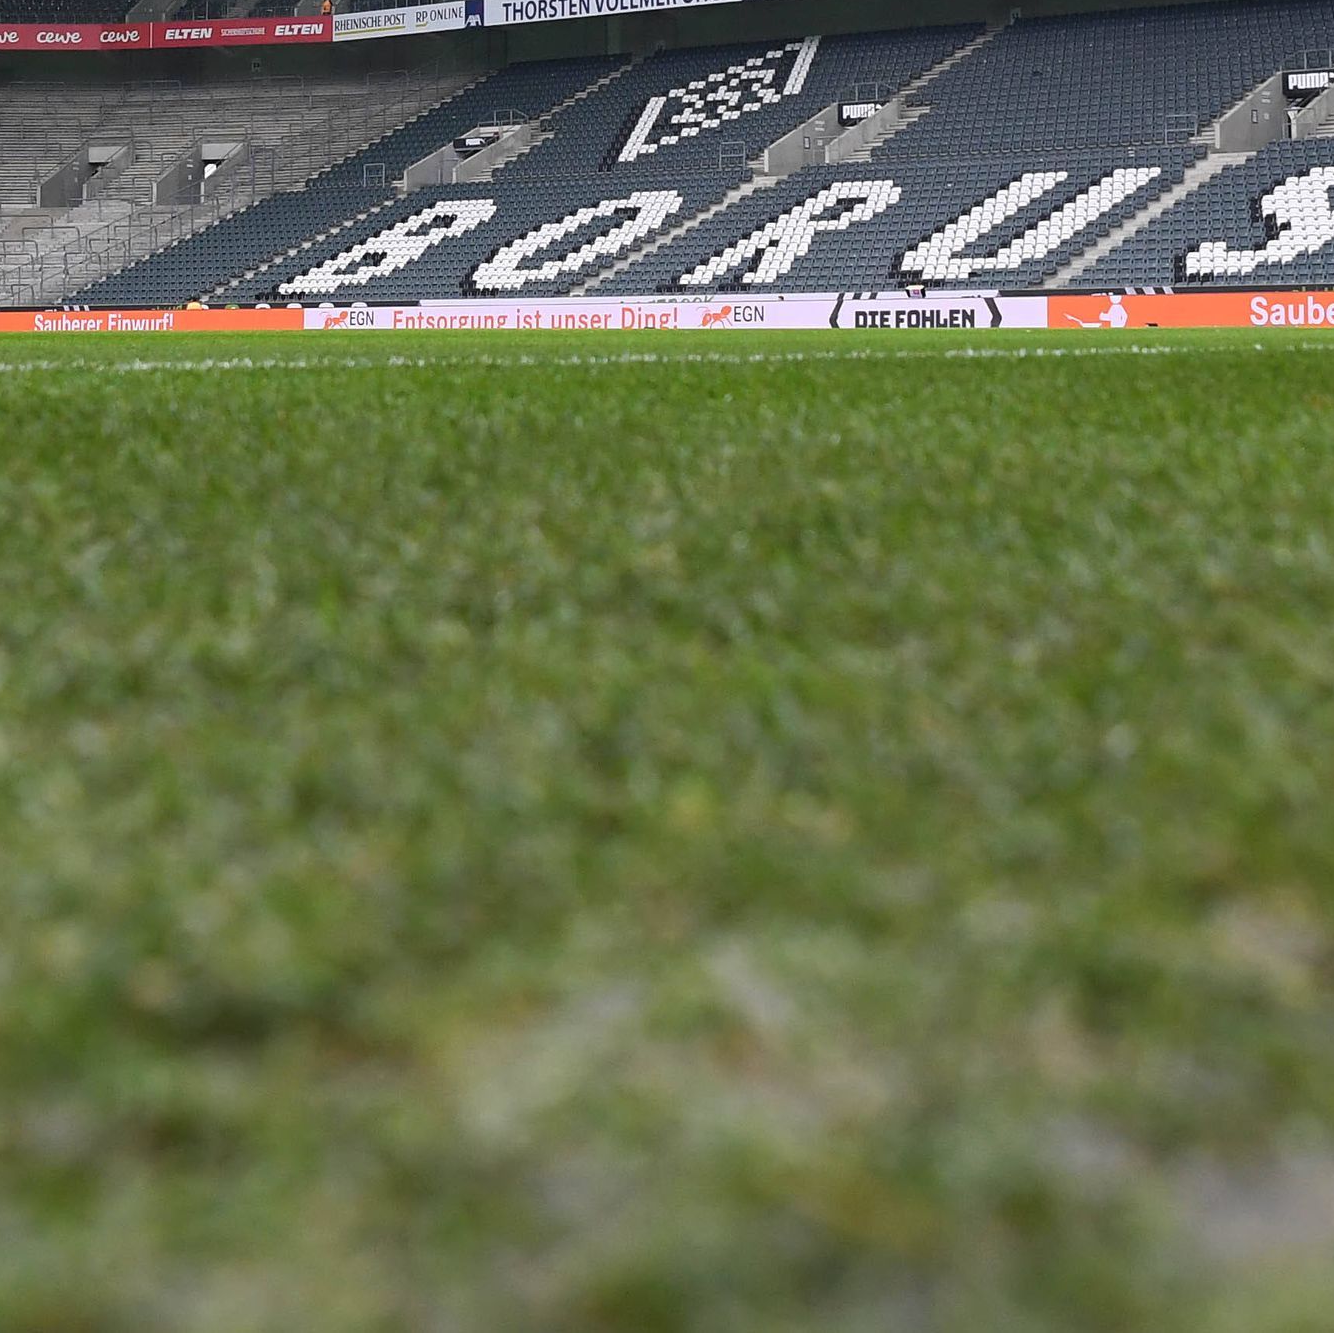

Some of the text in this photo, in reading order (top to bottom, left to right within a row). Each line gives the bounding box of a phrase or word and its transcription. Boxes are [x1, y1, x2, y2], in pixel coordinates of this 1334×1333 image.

[334, 7, 464, 32] RHEINISCHE POST RP ONLINE
[36, 30, 82, 44] cewe
[100, 29, 140, 43] cewe
[165, 27, 213, 40] ELTEN
[274, 23, 323, 36] ELTEN
[1288, 72, 1329, 90] PUMA
[34, 313, 174, 331] Sauberer Einwurf!
[349, 311, 375, 326] EGN
[393, 307, 678, 329] Entsorgung ist unser Ding!
[733, 306, 765, 322] EGN
[855, 309, 975, 328] DIE FOHLEN
